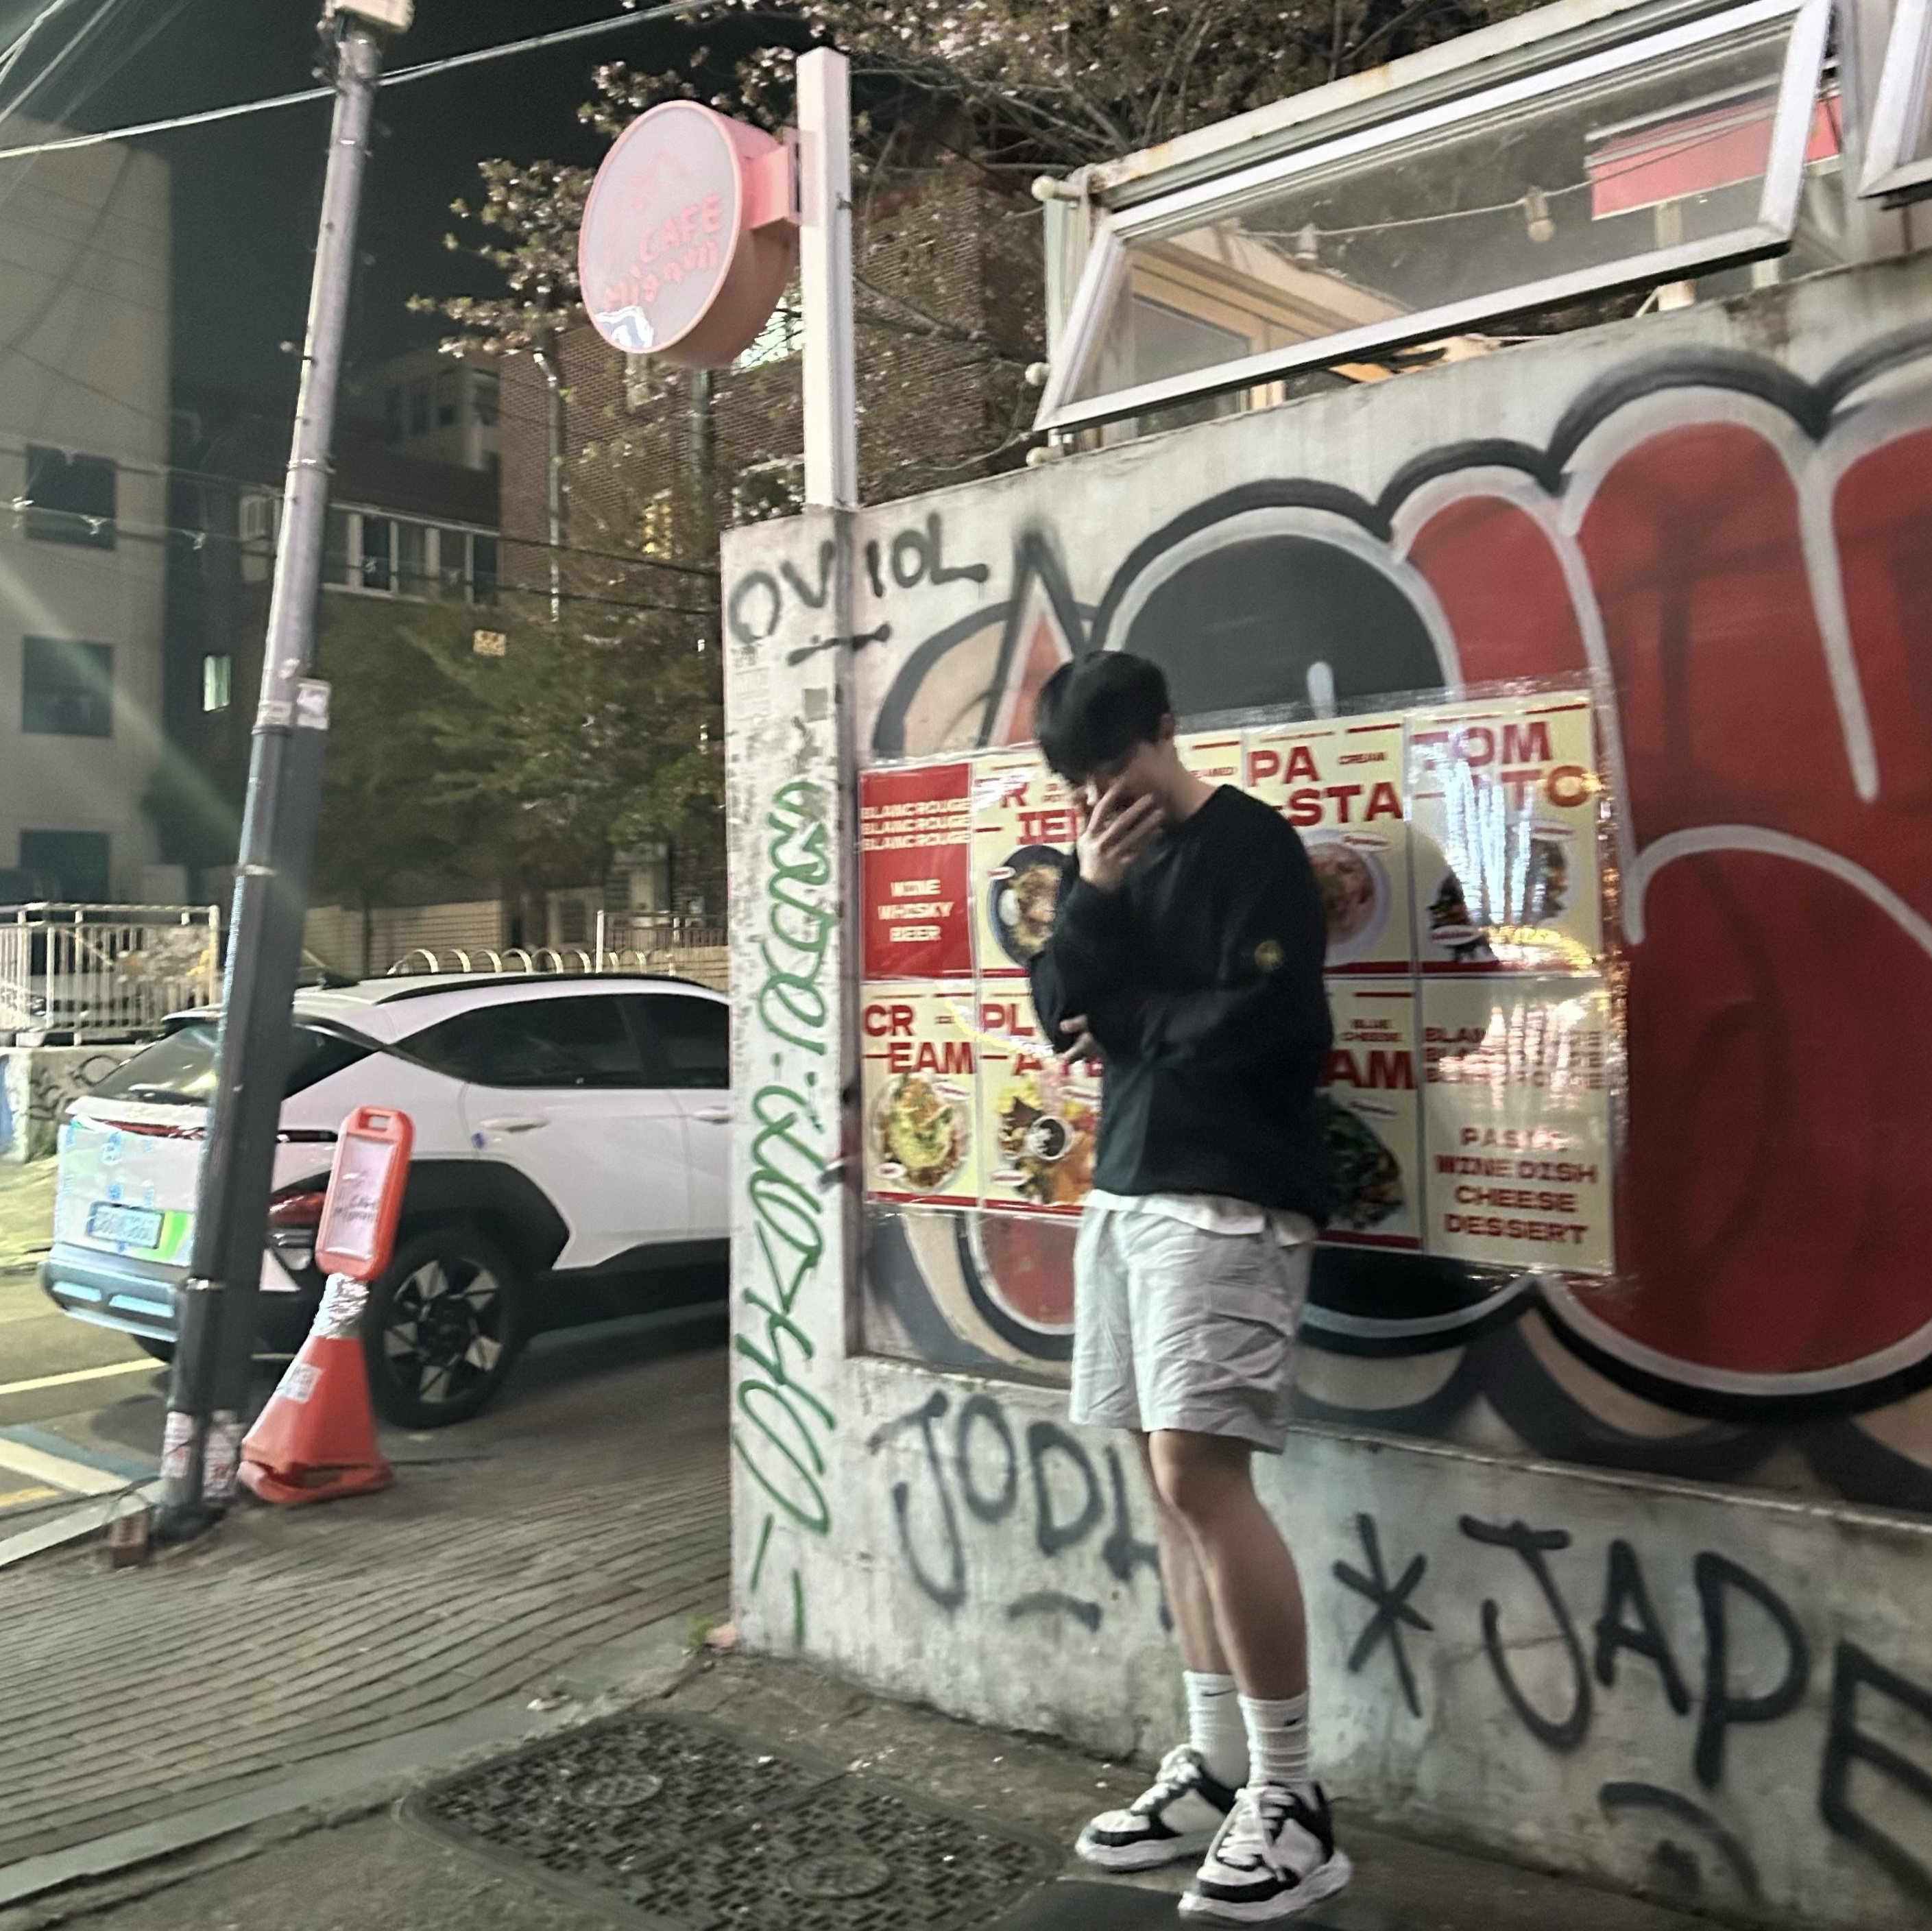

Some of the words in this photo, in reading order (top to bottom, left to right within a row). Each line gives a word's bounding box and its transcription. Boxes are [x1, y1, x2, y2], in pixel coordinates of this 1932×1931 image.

[639, 193, 723, 263] CAFE
[1247, 745, 1322, 787] PA
[1288, 781, 1404, 828] STA
[878, 901, 954, 920] WHISKY
[890, 925, 941, 942] BEER
[862, 1003, 915, 1037] CR
[982, 1003, 1037, 1036] PL
[888, 1041, 977, 1075] EAM
[1436, 1154, 1513, 1178] WINE
[1518, 1160, 1597, 1184] DISH
[1455, 1185, 1578, 1213] CHEESE
[1444, 1213, 1589, 1245] DESSERT
